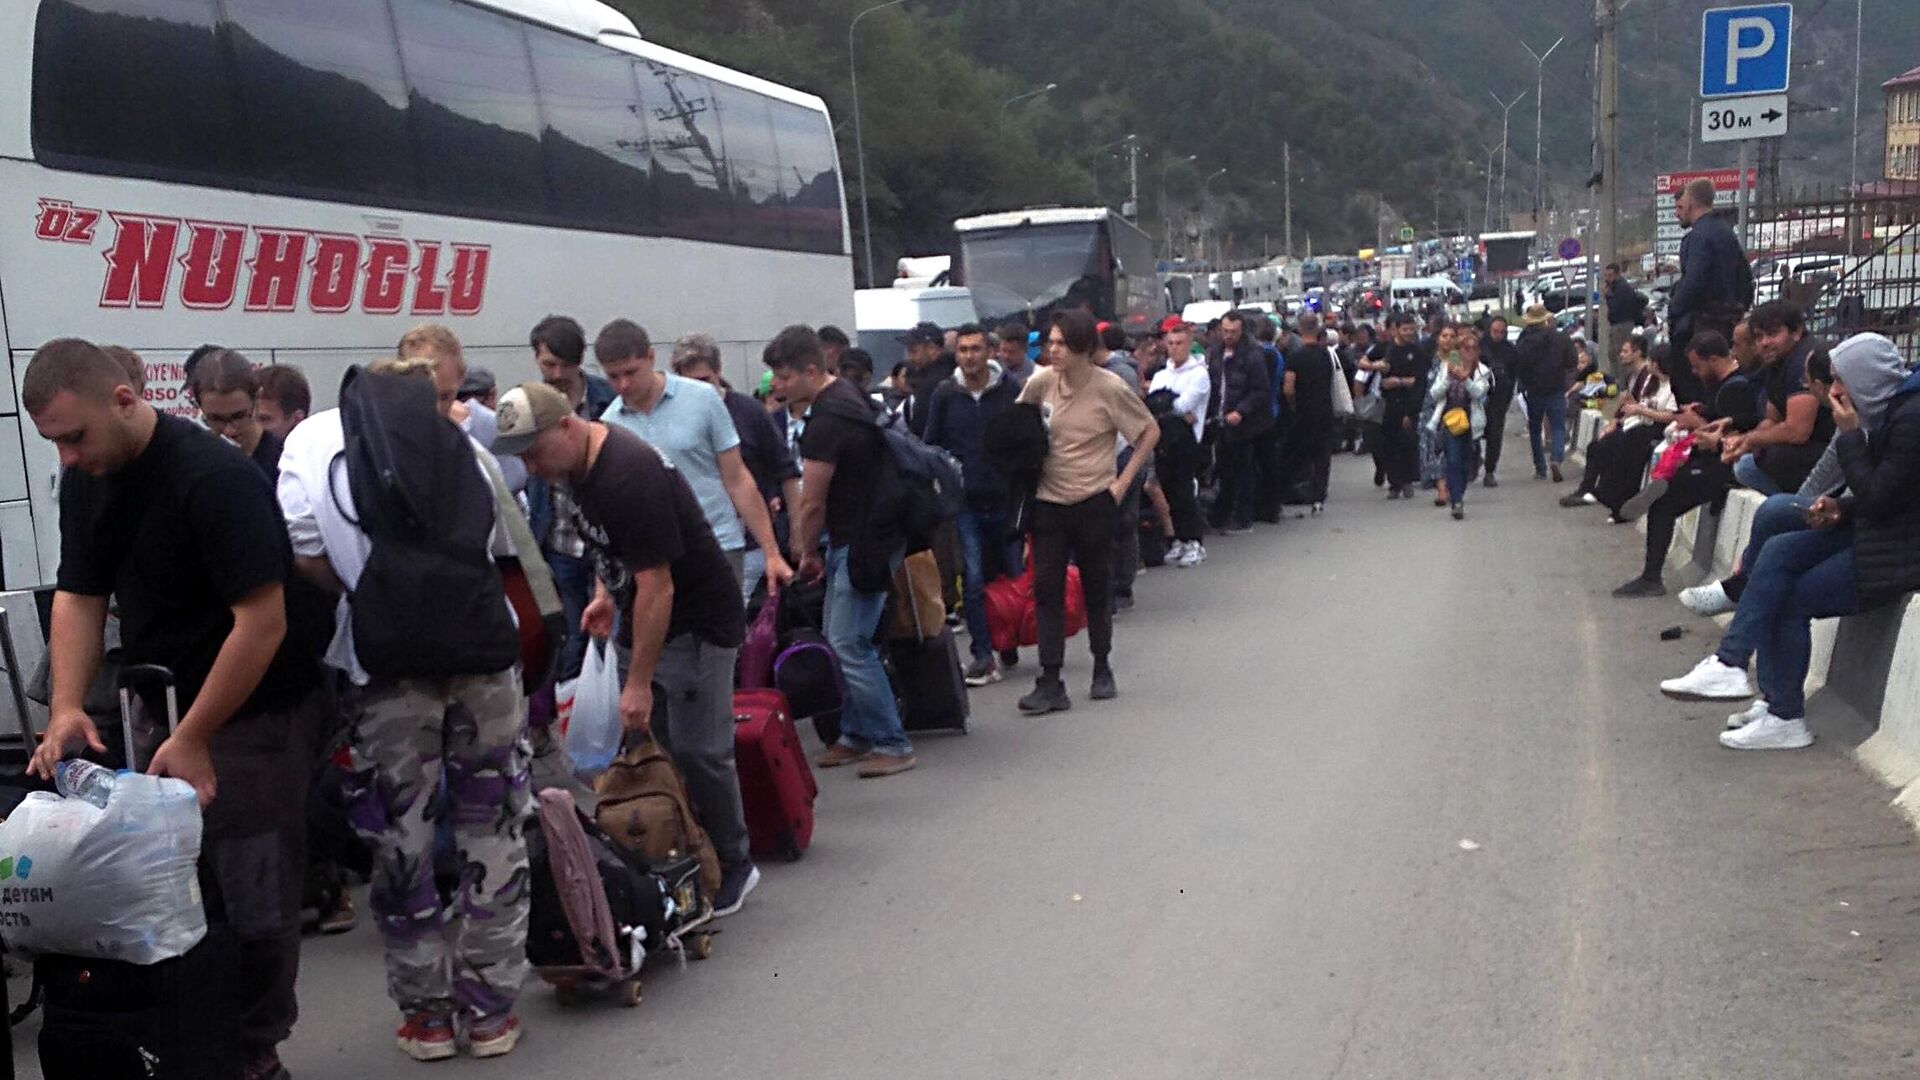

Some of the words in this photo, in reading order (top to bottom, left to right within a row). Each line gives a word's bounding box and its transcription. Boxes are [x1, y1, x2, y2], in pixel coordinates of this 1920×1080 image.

[1725, 16, 1775, 85] P
[144, 387, 177, 401] 850
[163, 403, 199, 420] nuhog
[2, 886, 54, 905] детям
